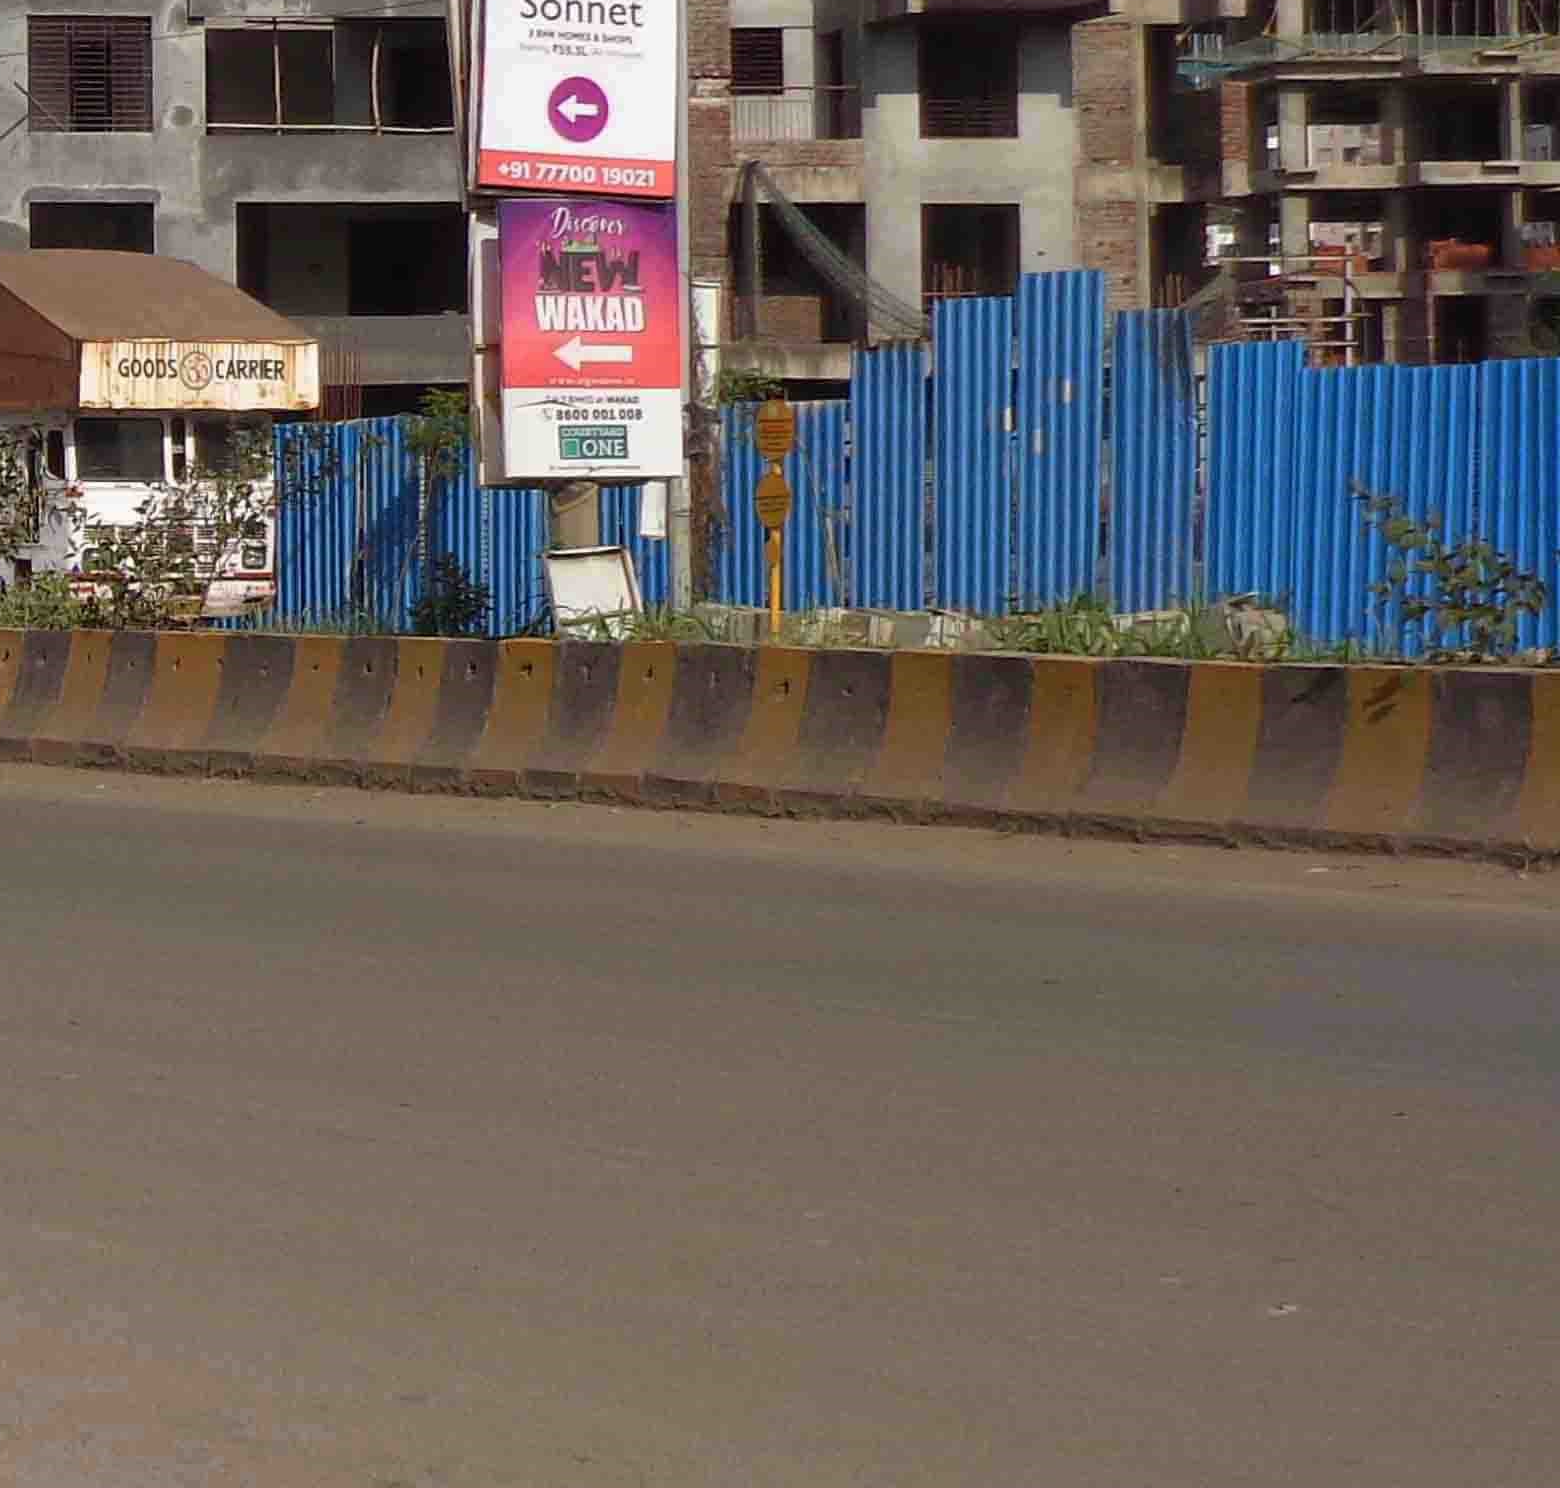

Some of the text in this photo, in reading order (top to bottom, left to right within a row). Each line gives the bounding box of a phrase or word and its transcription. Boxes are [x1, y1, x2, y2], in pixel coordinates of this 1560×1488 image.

[497, 161, 655, 187] +91 77700 19021
[550, 207, 625, 239] Discover
[539, 250, 642, 293] NEW
[535, 295, 645, 333] WAKAD
[118, 357, 177, 379] GOODS
[215, 359, 285, 380] CARRIER
[581, 439, 626, 457] ONE
